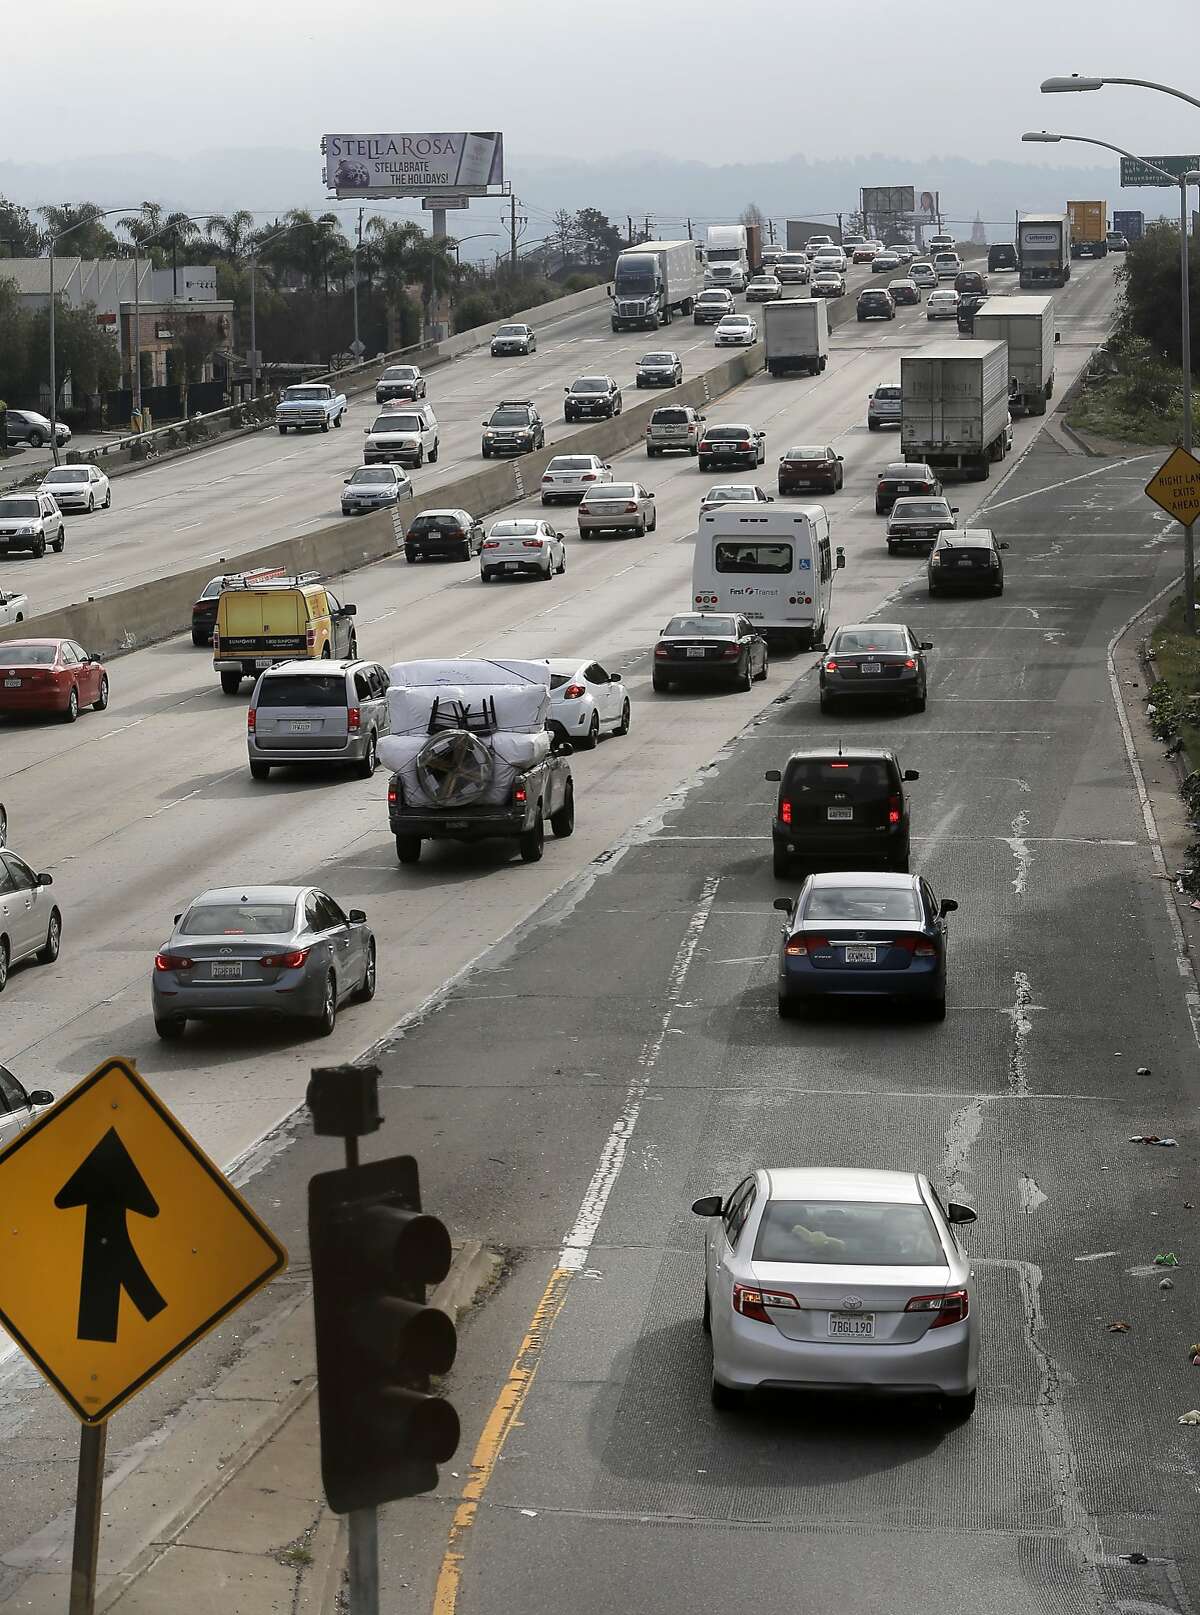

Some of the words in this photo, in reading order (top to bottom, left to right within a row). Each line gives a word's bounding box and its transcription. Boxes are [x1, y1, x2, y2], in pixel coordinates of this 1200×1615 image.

[375, 162, 429, 172] STELLABRATE
[391, 174, 407, 184] THE
[408, 173, 449, 184] HOLIDAYS!
[1159, 475, 1182, 486] RIGHT
[1173, 487, 1195, 497] EXITS
[1172, 499, 1199, 511] AHEAD
[755, 588, 778, 596] Transit
[832, 1321, 872, 1333] 7BGL190
